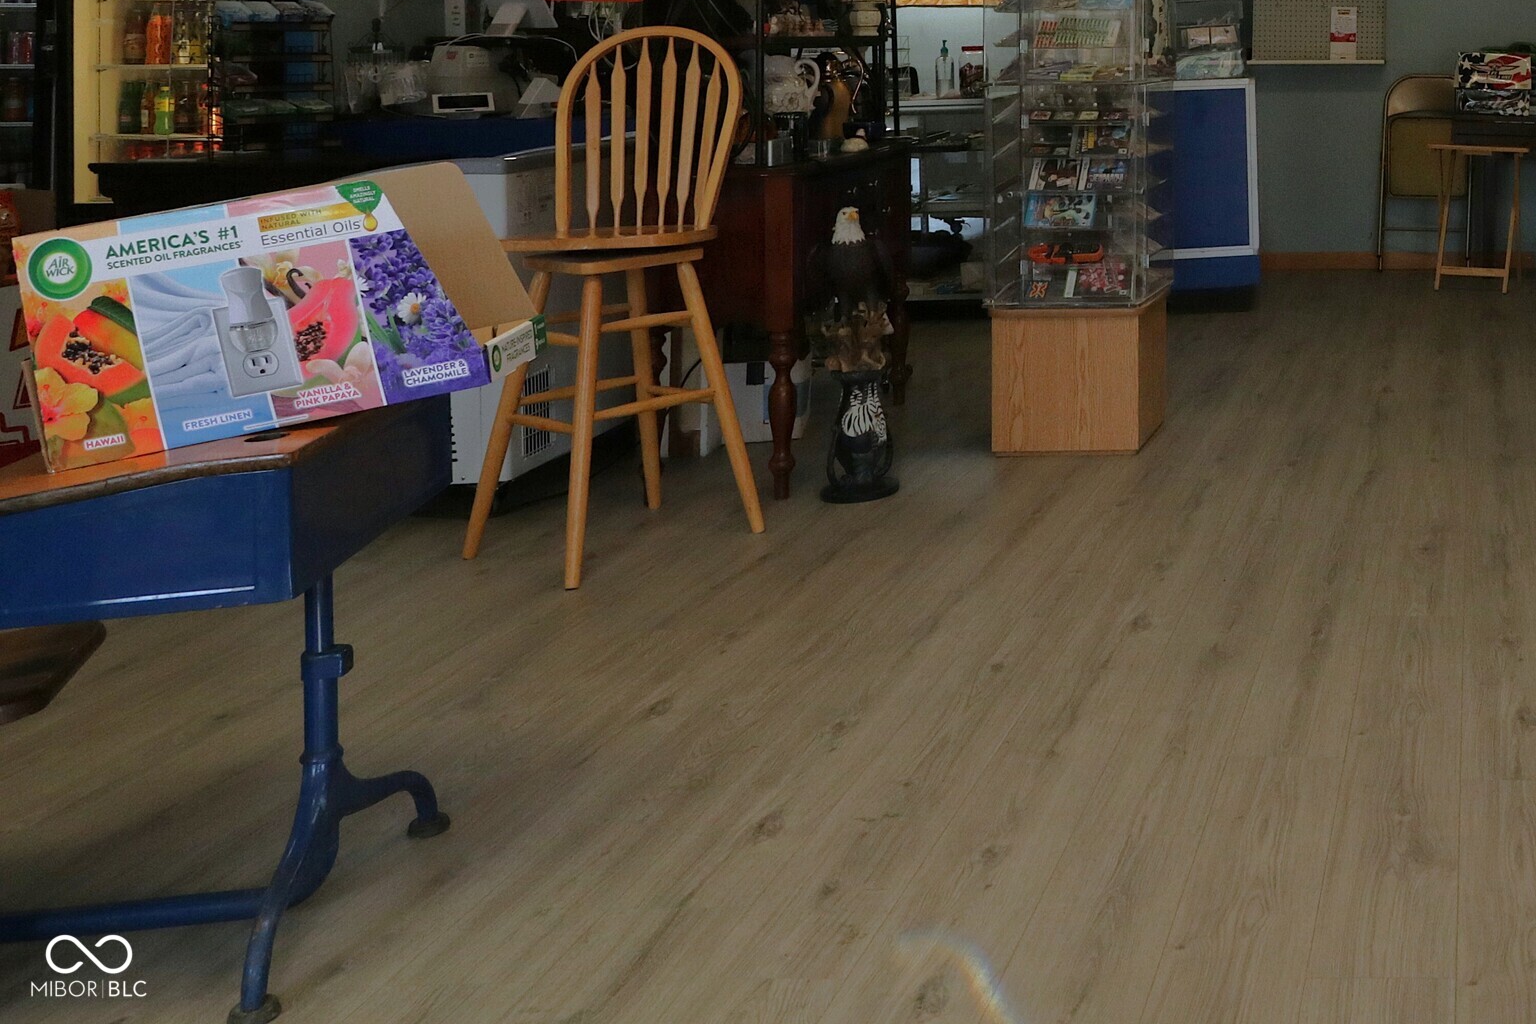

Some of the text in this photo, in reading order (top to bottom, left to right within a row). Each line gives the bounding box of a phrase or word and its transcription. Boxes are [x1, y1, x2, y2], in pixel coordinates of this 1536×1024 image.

[260, 209, 322, 224] INFUSED WITH
[261, 220, 301, 230] NATURAL
[261, 220, 361, 246] Essential Oils
[105, 226, 239, 260] AMERICA'S #1
[107, 256, 153, 270] SCENTED
[155, 253, 171, 263] OIL
[45, 266, 75, 278] WICK
[403, 360, 466, 378] LAVENDER &
[406, 368, 468, 386] CHAMOMILE
[295, 390, 360, 409] PINK PAPAYA
[299, 386, 342, 399] VANILLA
[185, 410, 251, 430] FRESH LINEN
[86, 436, 125, 449] HAWAII
